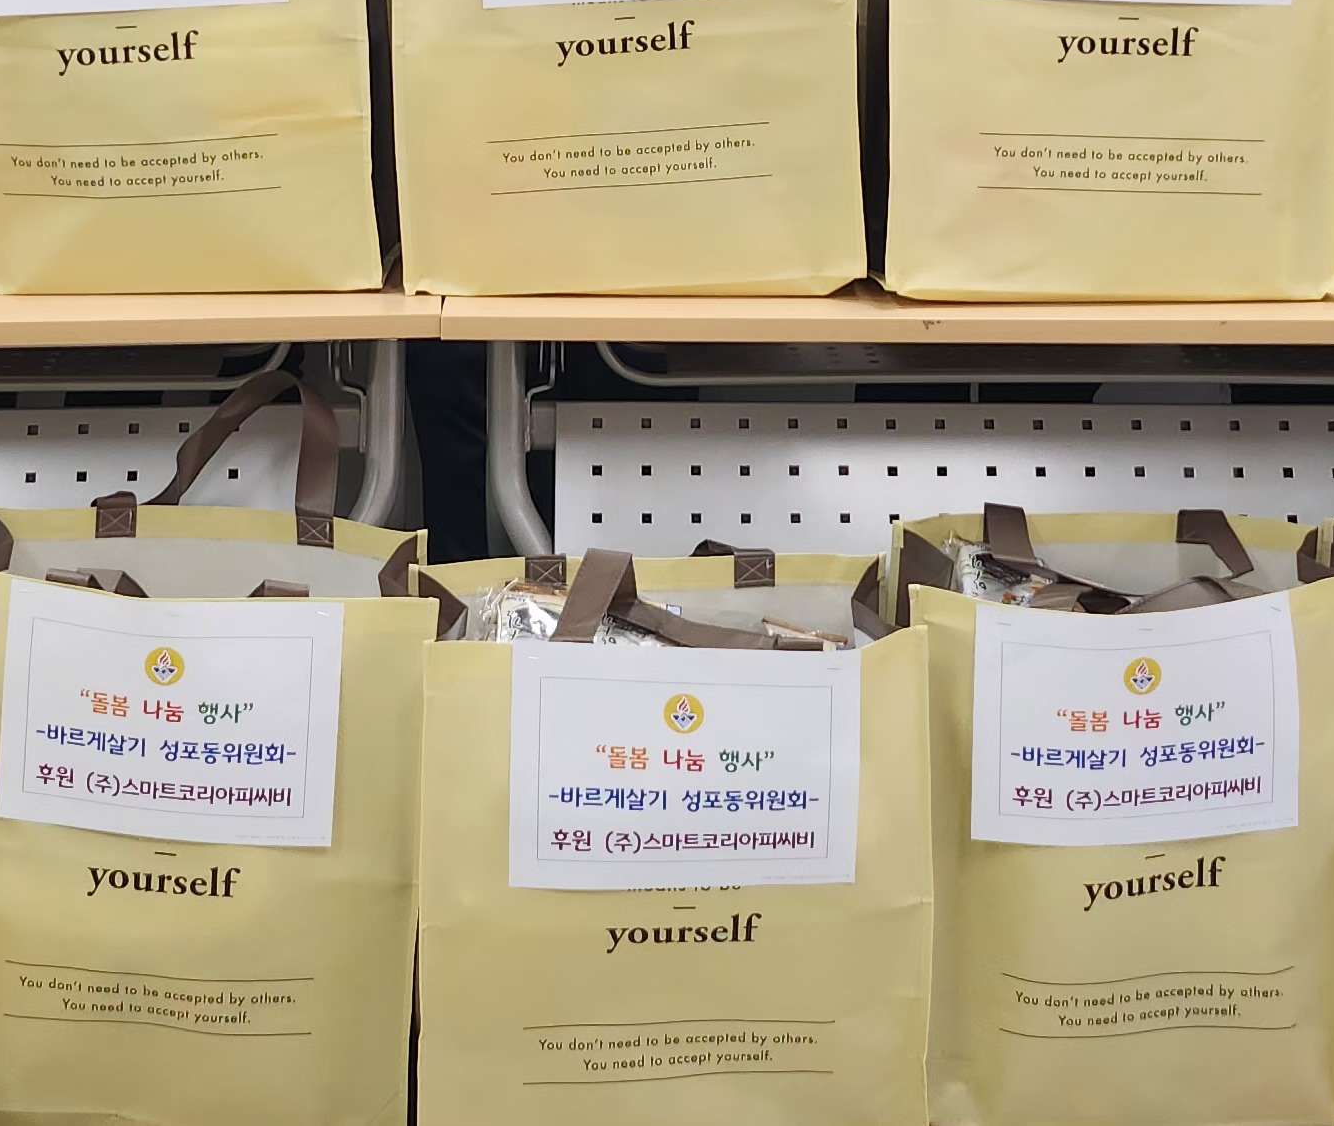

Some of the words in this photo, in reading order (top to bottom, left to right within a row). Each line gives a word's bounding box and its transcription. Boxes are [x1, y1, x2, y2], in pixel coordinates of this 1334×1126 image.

[56, 29, 199, 77] yourself
[555, 19, 695, 68] yourself
[1057, 26, 1200, 64] yourself
[993, 145, 1016, 158] You
[1056, 147, 1087, 160] need
[1091, 149, 1104, 160] to
[1108, 148, 1123, 161] be
[1127, 149, 1183, 165] accepted
[1187, 150, 1203, 166] by
[1033, 165, 1055, 178] You
[1059, 166, 1090, 179] need
[1094, 169, 1107, 179] to
[1111, 170, 1152, 184] accept
[143, 699, 185, 723] 나눔
[1123, 708, 1163, 730] 나눔
[663, 748, 706, 773] 나눔
[35, 763, 74, 789] 후원
[86, 771, 292, 807] (주)스마트코리아피씨비
[1012, 785, 1053, 810] 후원
[1066, 775, 1261, 812] (주)스마트코리아피씨비
[550, 828, 592, 852] 후원
[605, 830, 815, 855] (주)스마트코리아피씨비
[86, 866, 241, 898] yourself
[1083, 853, 1227, 912] yourself
[605, 912, 763, 954] yourself
[538, 1038, 563, 1051] You
[608, 1034, 641, 1050] need
[646, 1036, 659, 1047] to
[664, 1033, 680, 1046] be
[685, 1031, 746, 1046] accepted
[751, 1031, 768, 1047] by
[583, 1058, 607, 1071] You
[612, 1054, 645, 1070] need
[650, 1055, 663, 1068] to
[668, 1051, 712, 1066] accept
